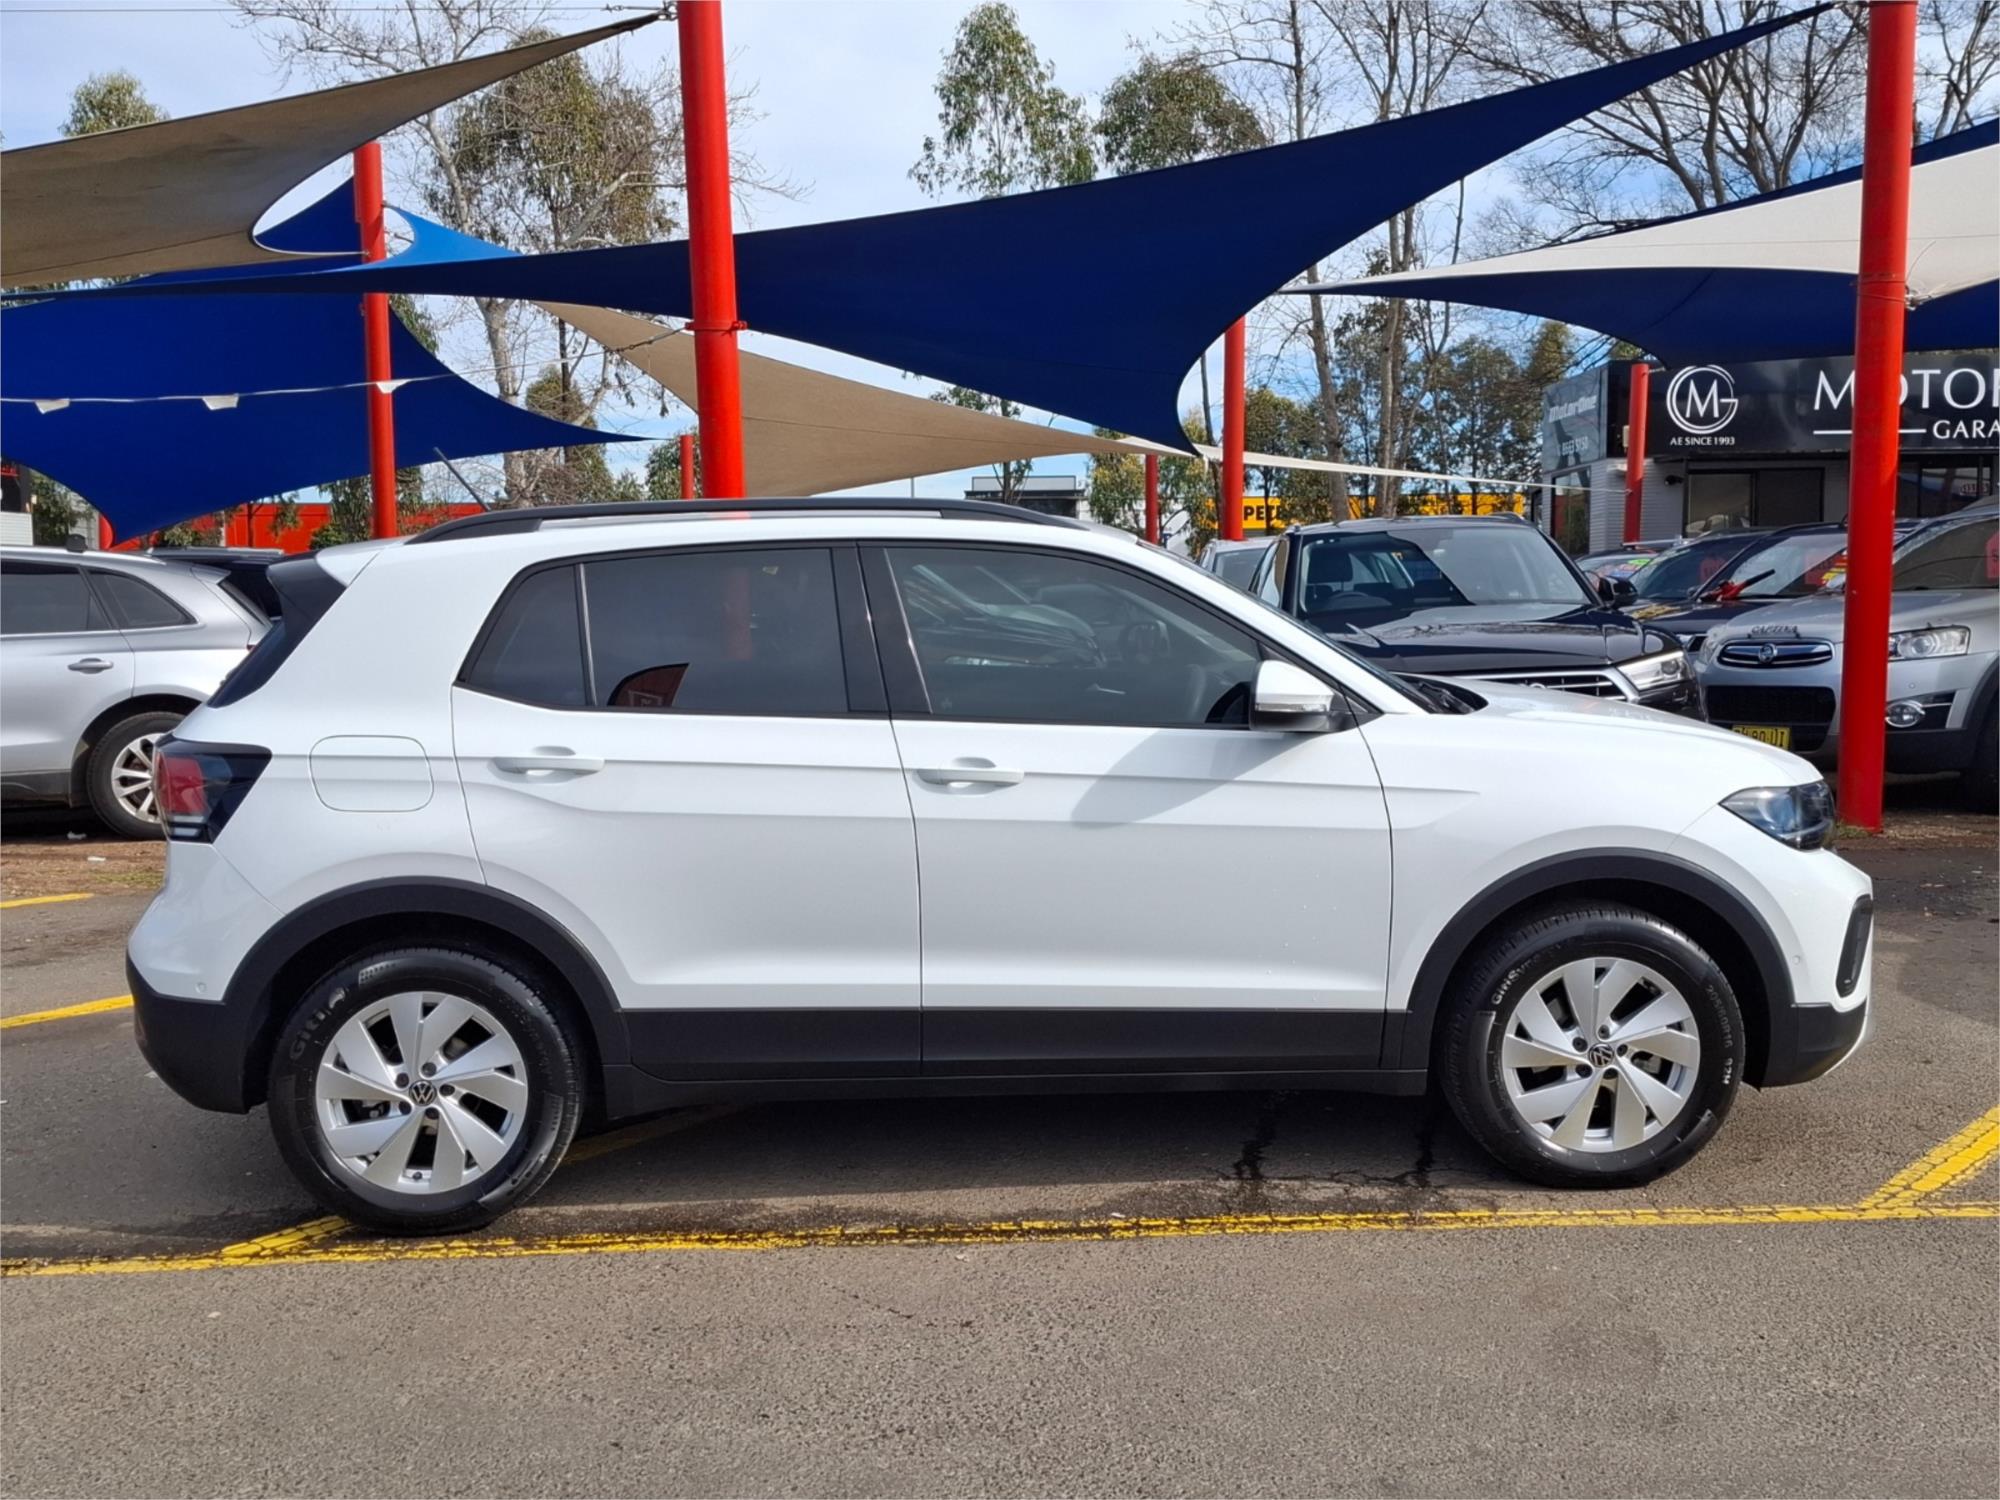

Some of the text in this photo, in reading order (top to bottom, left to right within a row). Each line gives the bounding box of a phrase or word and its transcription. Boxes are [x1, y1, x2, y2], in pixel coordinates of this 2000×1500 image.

[1814, 368, 1999, 410] MTO
[1669, 437, 1736, 446] AE SINCE 1993
